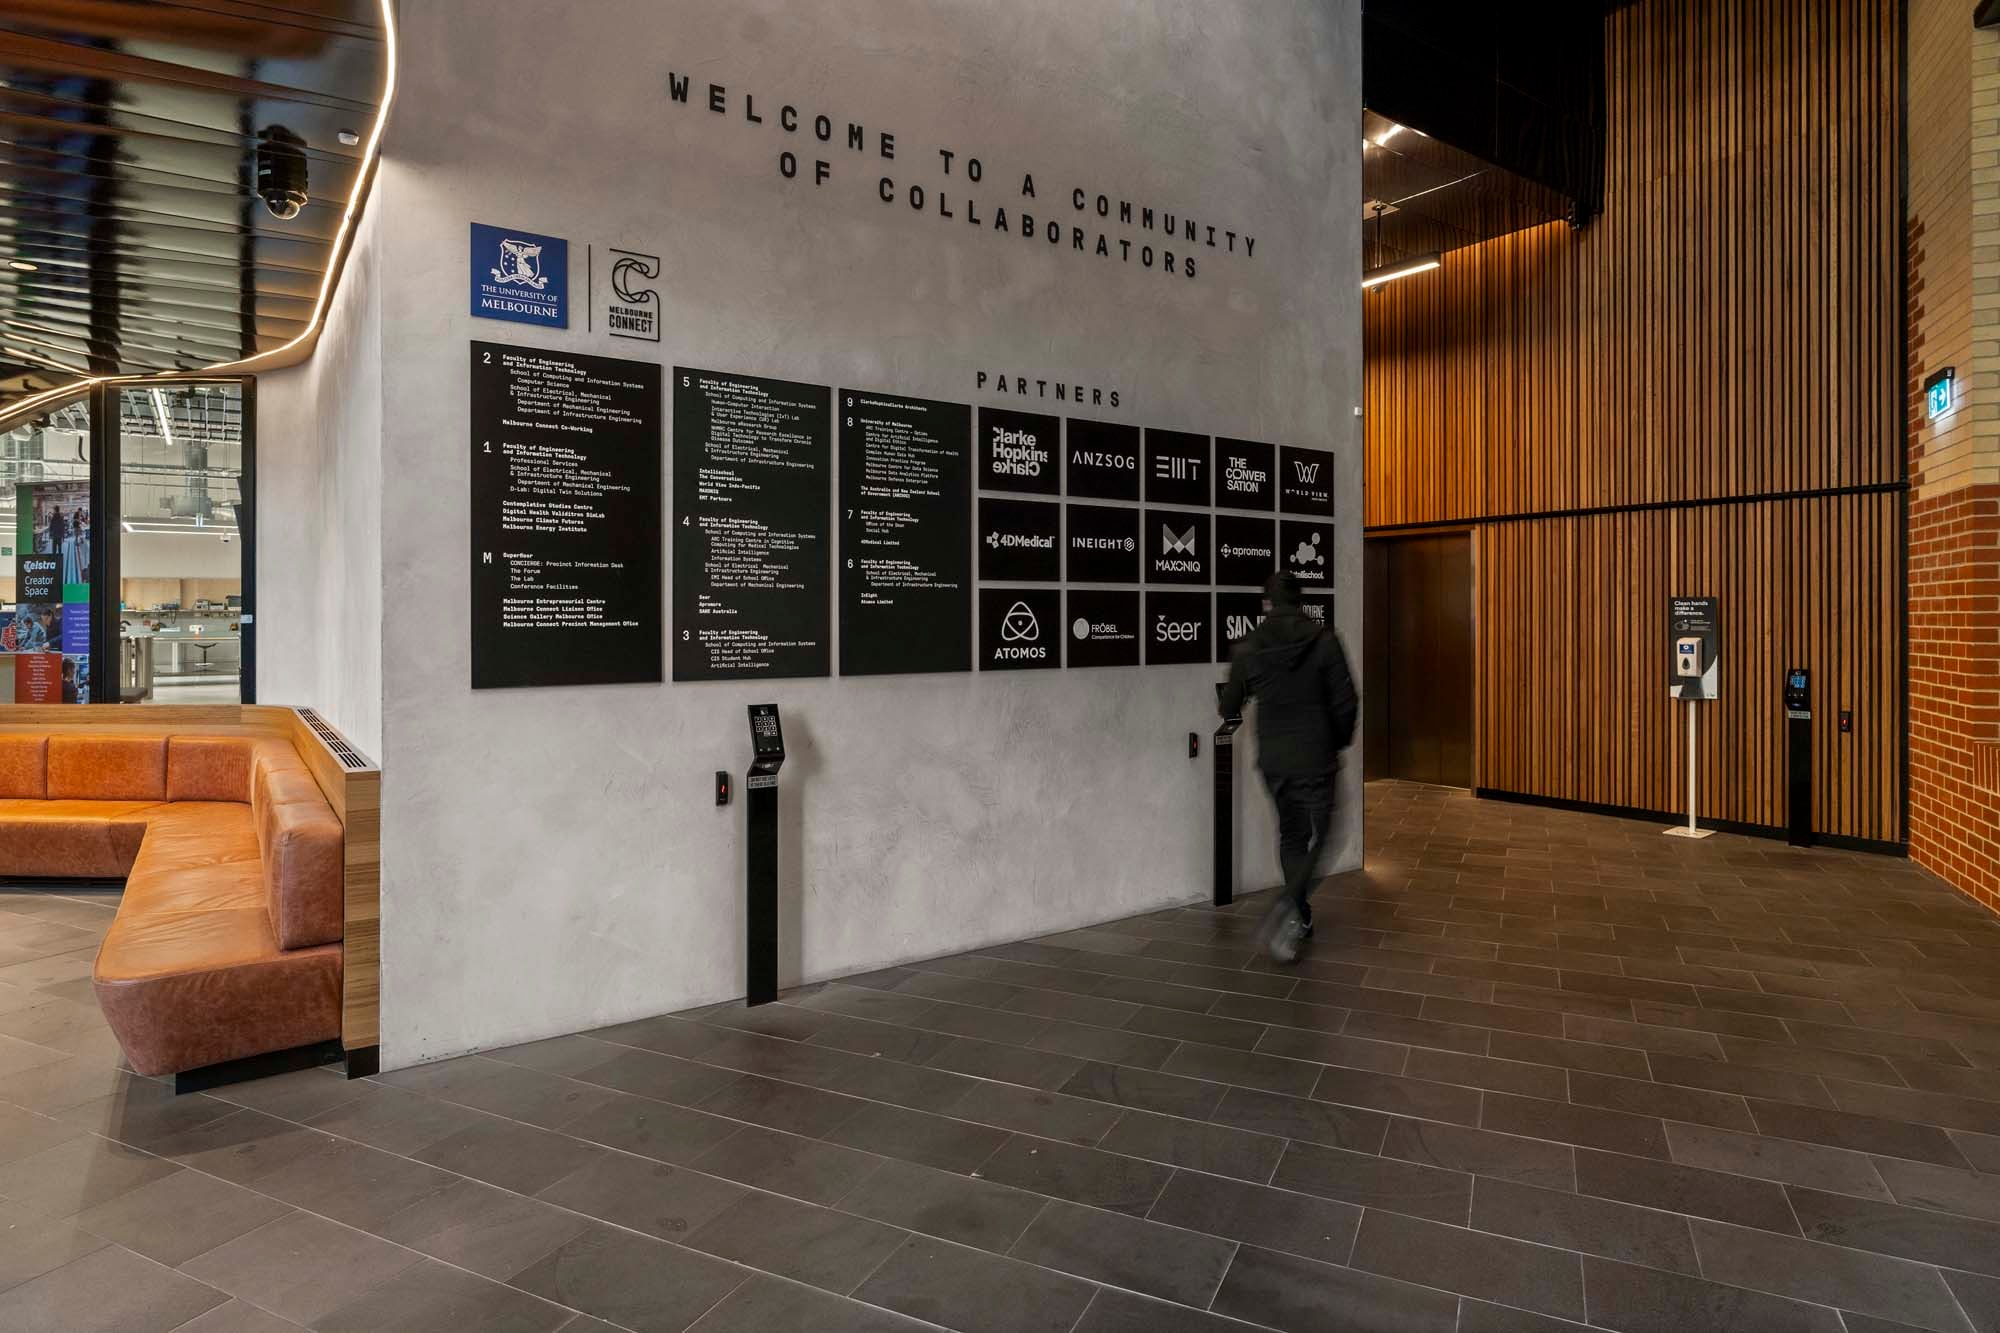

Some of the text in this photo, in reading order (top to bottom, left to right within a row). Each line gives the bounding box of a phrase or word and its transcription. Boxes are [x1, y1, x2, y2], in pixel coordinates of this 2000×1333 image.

[668, 72, 1256, 258] WELCOME TO A COMMUNITY
[780, 152, 1196, 278] OF COLLABORATORS
[481, 284, 497, 293] THE
[499, 287, 546, 301] UNIVERSITY
[481, 298, 558, 318] MELBOURNE
[609, 306, 652, 319] MELBOURNE
[609, 315, 652, 333] CONNECT
[483, 352, 491, 364] 2
[503, 354, 526, 363] Faculty
[539, 359, 574, 369] Engineering
[683, 377, 690, 387] 5
[977, 372, 1120, 407] PARTNERS
[565, 396, 600, 406] Engineering
[847, 397, 853, 407] 9
[597, 407, 630, 416] Engineering
[609, 416, 642, 424] Engineering
[847, 417, 853, 426] 8
[483, 441, 492, 453] 1
[539, 446, 574, 454] Engineering
[1229, 457, 1247, 469] THE
[1226, 468, 1266, 482] CONVER
[1227, 480, 1259, 493] SATION
[848, 510, 853, 519] 7
[683, 516, 690, 526] 4
[1073, 537, 1123, 549] INEIGHT
[483, 552, 492, 564] M
[1232, 547, 1271, 557] apromore
[24, 560, 56, 572] Telstra
[847, 559, 853, 568] 6
[25, 576, 54, 585] Creator
[25, 586, 48, 597] Space
[683, 631, 689, 640] 3
[994, 647, 1046, 660] ATOMOS
